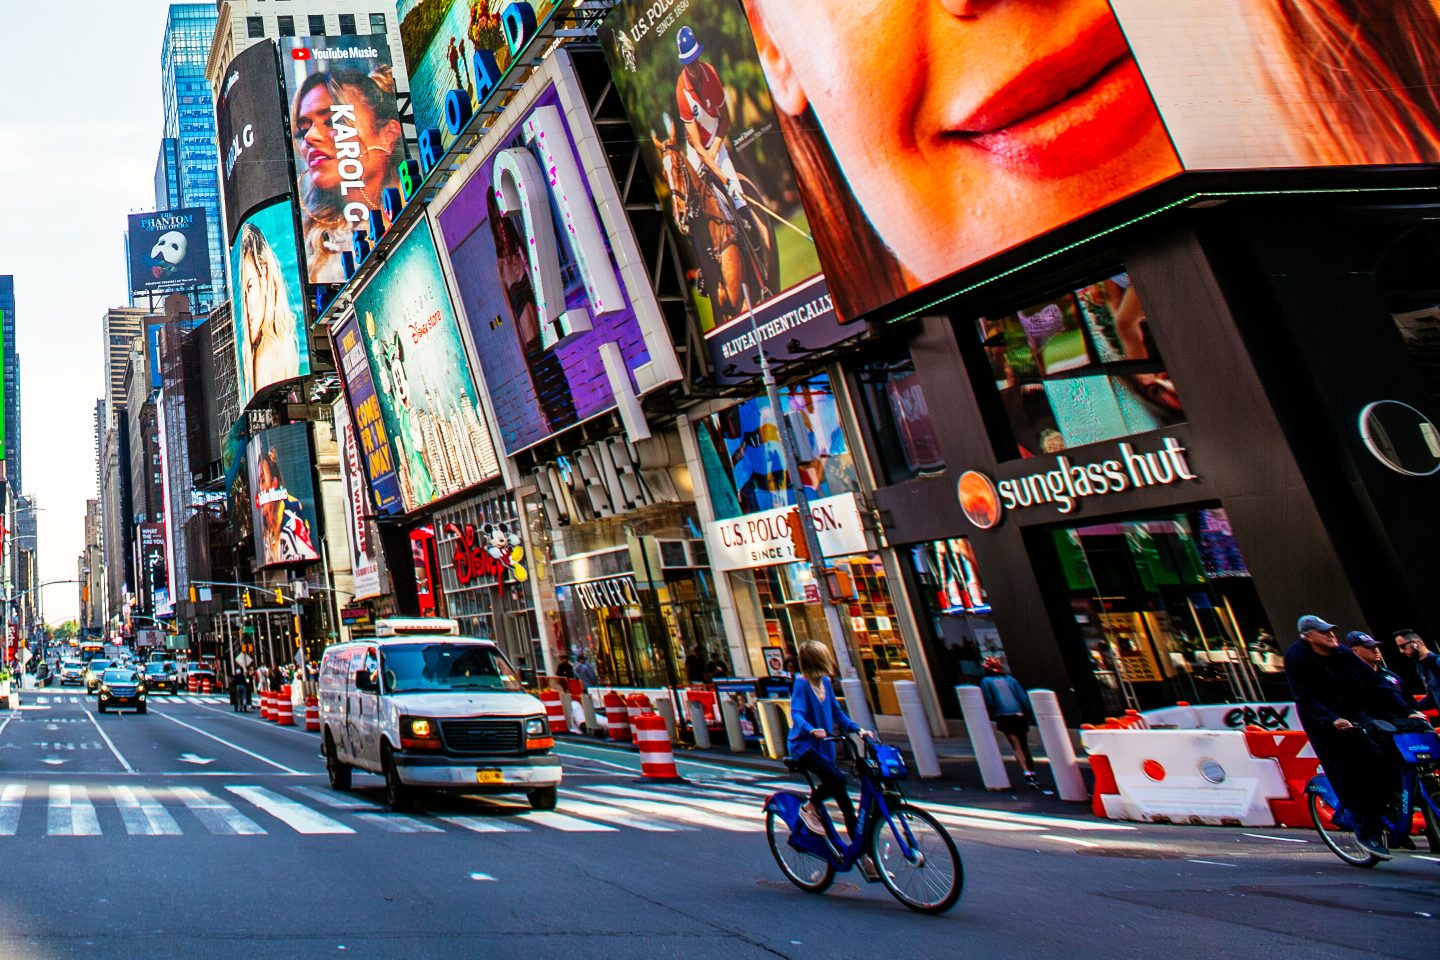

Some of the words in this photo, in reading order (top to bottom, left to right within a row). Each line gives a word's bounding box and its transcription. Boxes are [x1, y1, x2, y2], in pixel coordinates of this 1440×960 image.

[630, 17, 650, 42] U.S.
[655, 12, 676, 38] SINCE
[312, 48, 348, 60] YouTube
[349, 47, 378, 59] Music
[242, 124, 255, 148] G
[329, 105, 368, 196] KAROL
[141, 214, 193, 229] PHANTOM
[342, 202, 370, 222] G
[996, 455, 1128, 514] sunglass
[1119, 436, 1198, 489] hut
[720, 523, 747, 548] U.S.
[748, 514, 790, 544] POLO
[751, 546, 783, 560] SINCE
[574, 578, 629, 611] FOREVER
